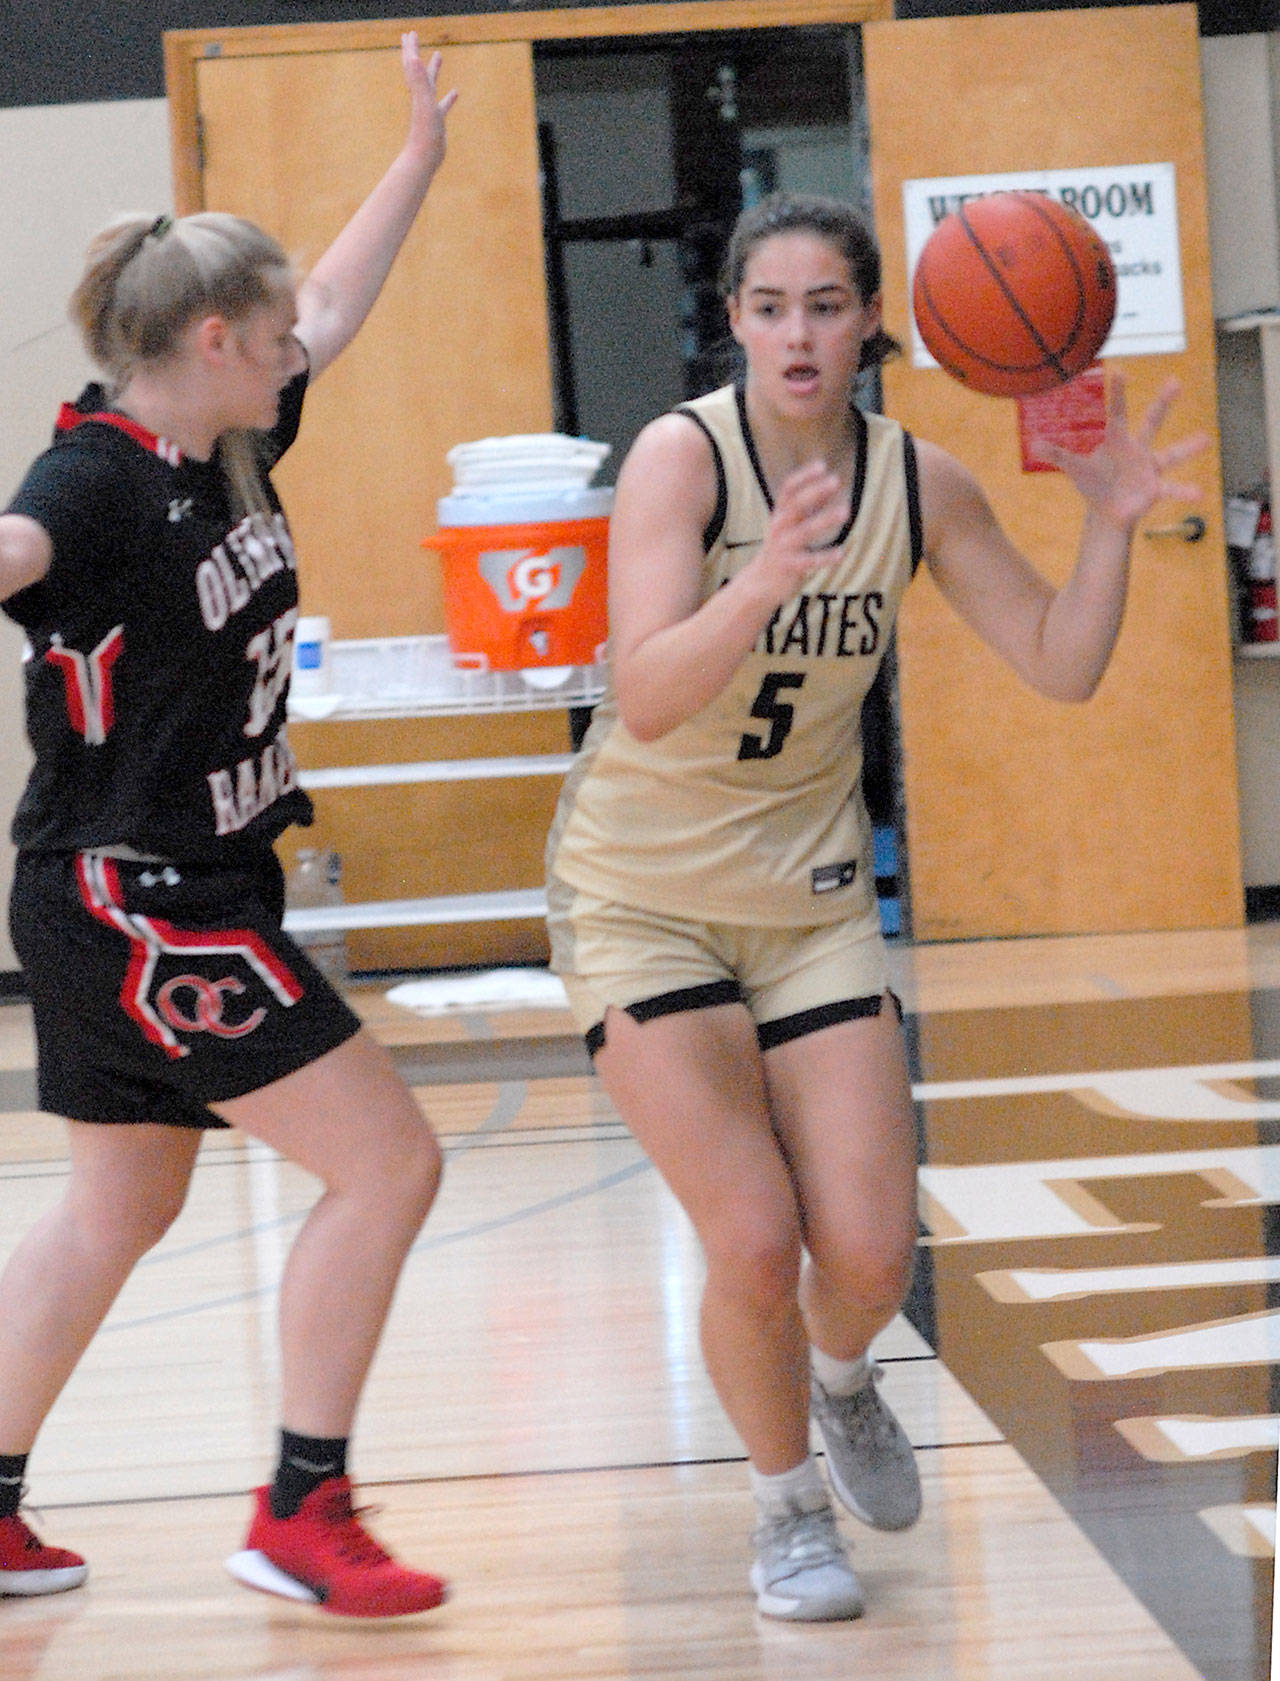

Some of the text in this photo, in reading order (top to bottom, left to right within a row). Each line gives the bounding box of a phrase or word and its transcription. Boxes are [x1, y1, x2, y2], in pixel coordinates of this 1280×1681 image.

[513, 555, 554, 598] G
[737, 671, 807, 761] 5
[156, 974, 268, 1039] OC
